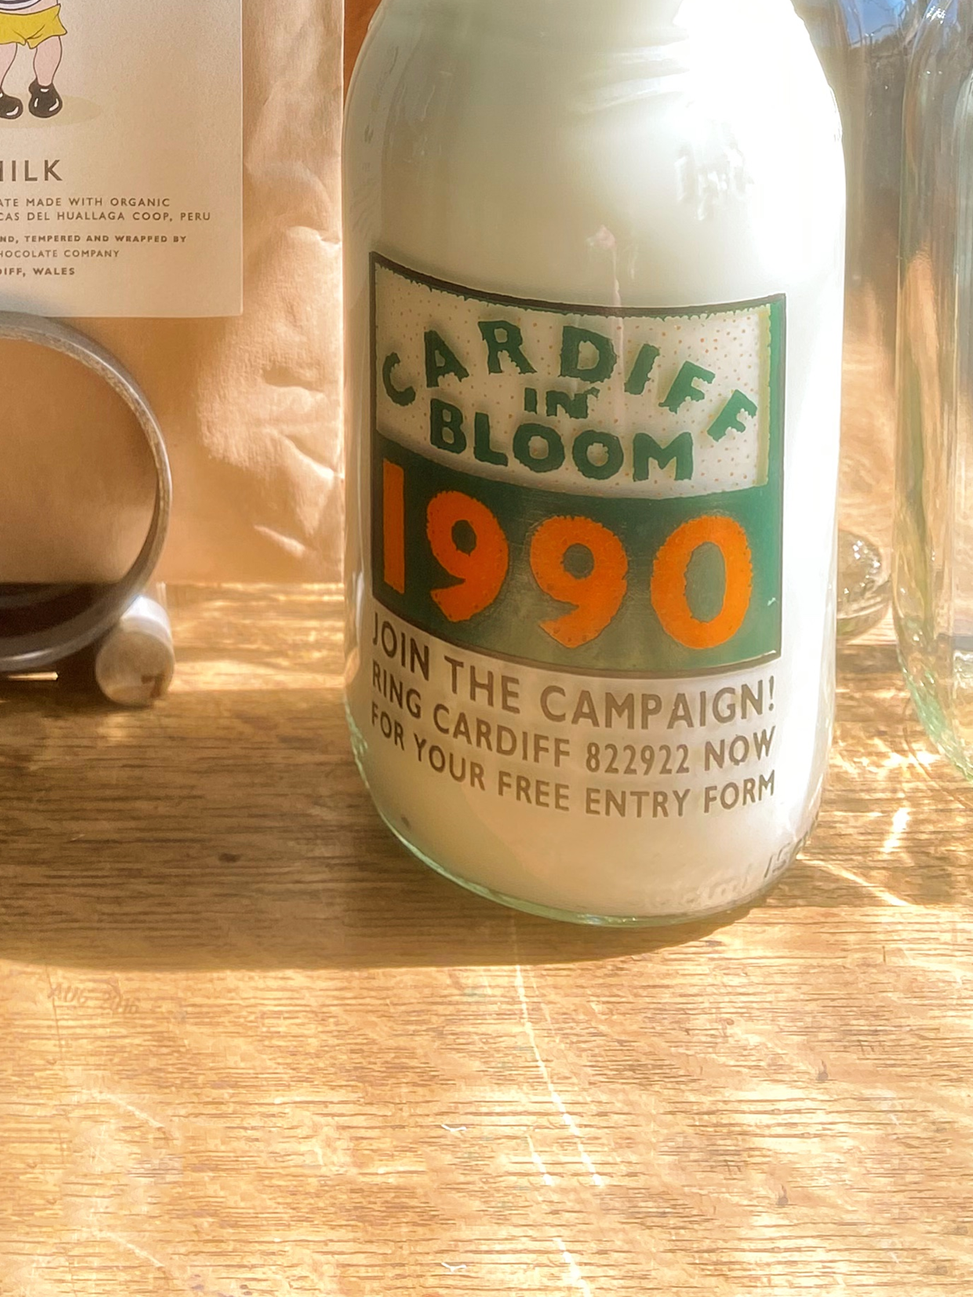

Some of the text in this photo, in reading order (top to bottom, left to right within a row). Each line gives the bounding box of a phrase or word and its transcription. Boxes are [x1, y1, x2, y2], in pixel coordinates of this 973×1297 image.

[26, 198, 61, 207] MADE
[68, 197, 106, 206] WITH
[110, 197, 171, 207] ORGANIC
[27, 212, 50, 221] DEL
[57, 211, 125, 221] HUALLAGA
[132, 212, 173, 222] COOP,
[180, 212, 210, 221] PERU
[24, 234, 81, 243] TEMPERED
[172, 235, 187, 243] BY
[64, 249, 120, 258] COMPANY
[32, 267, 75, 275] WALES
[382, 320, 758, 442] CARDIFF
[524, 387, 600, 419] IN
[430, 399, 693, 482] BLOOM
[383, 458, 754, 650] 1990
[373, 613, 776, 730] JOIN THE CAMPAIGN!
[373, 660, 776, 776] RING CARDIFF 822922 NOW
[372, 703, 776, 819] FOR YOUR FREE ENTRY FORM
